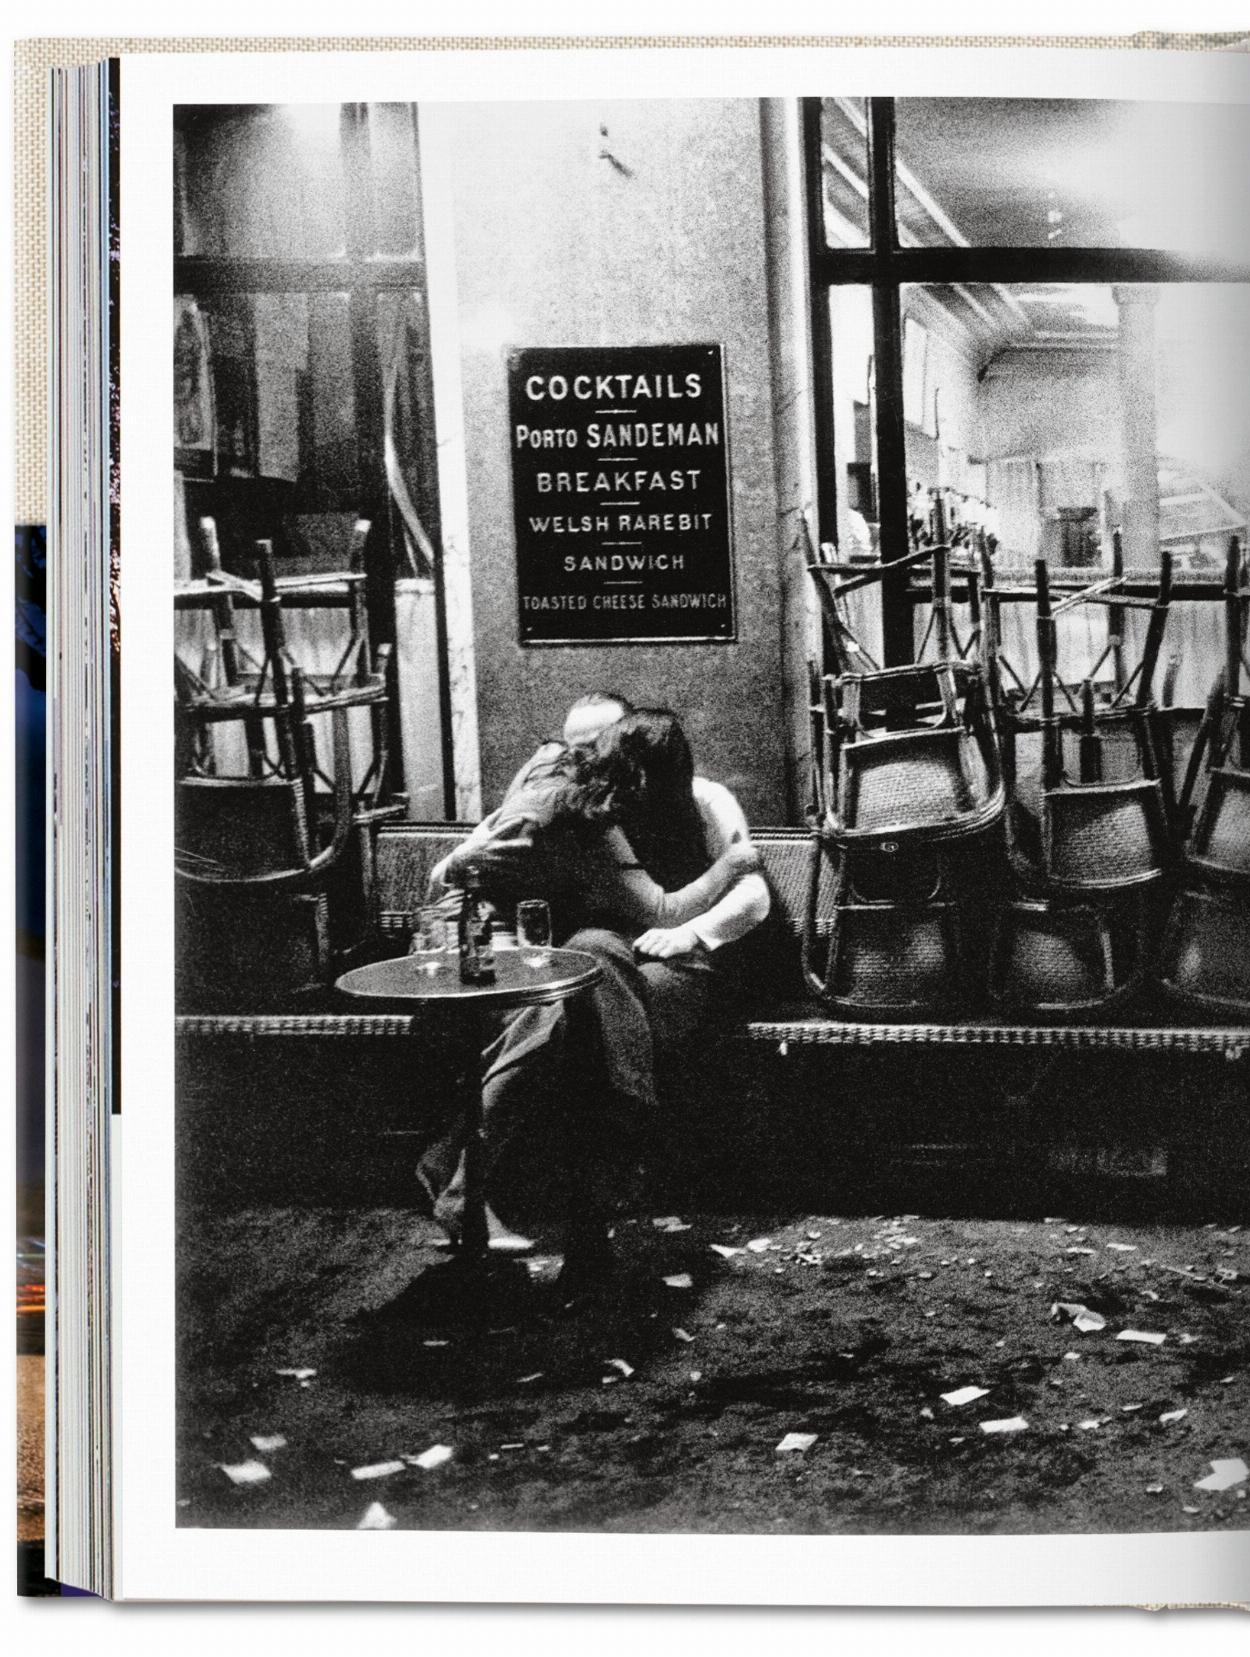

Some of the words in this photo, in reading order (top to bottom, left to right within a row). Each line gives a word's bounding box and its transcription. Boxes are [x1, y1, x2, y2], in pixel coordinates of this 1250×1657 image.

[525, 373, 702, 400] COCKTAILS
[586, 422, 719, 448] SANDEMAN
[537, 470, 702, 493] BREAKFAST
[530, 516, 609, 533] WELSH
[618, 513, 713, 531] RAREBIT
[564, 554, 685, 572] SANDWICH
[523, 594, 587, 611] TOASTED
[593, 594, 645, 610] CHEESE
[651, 593, 727, 610] SANDWICH
